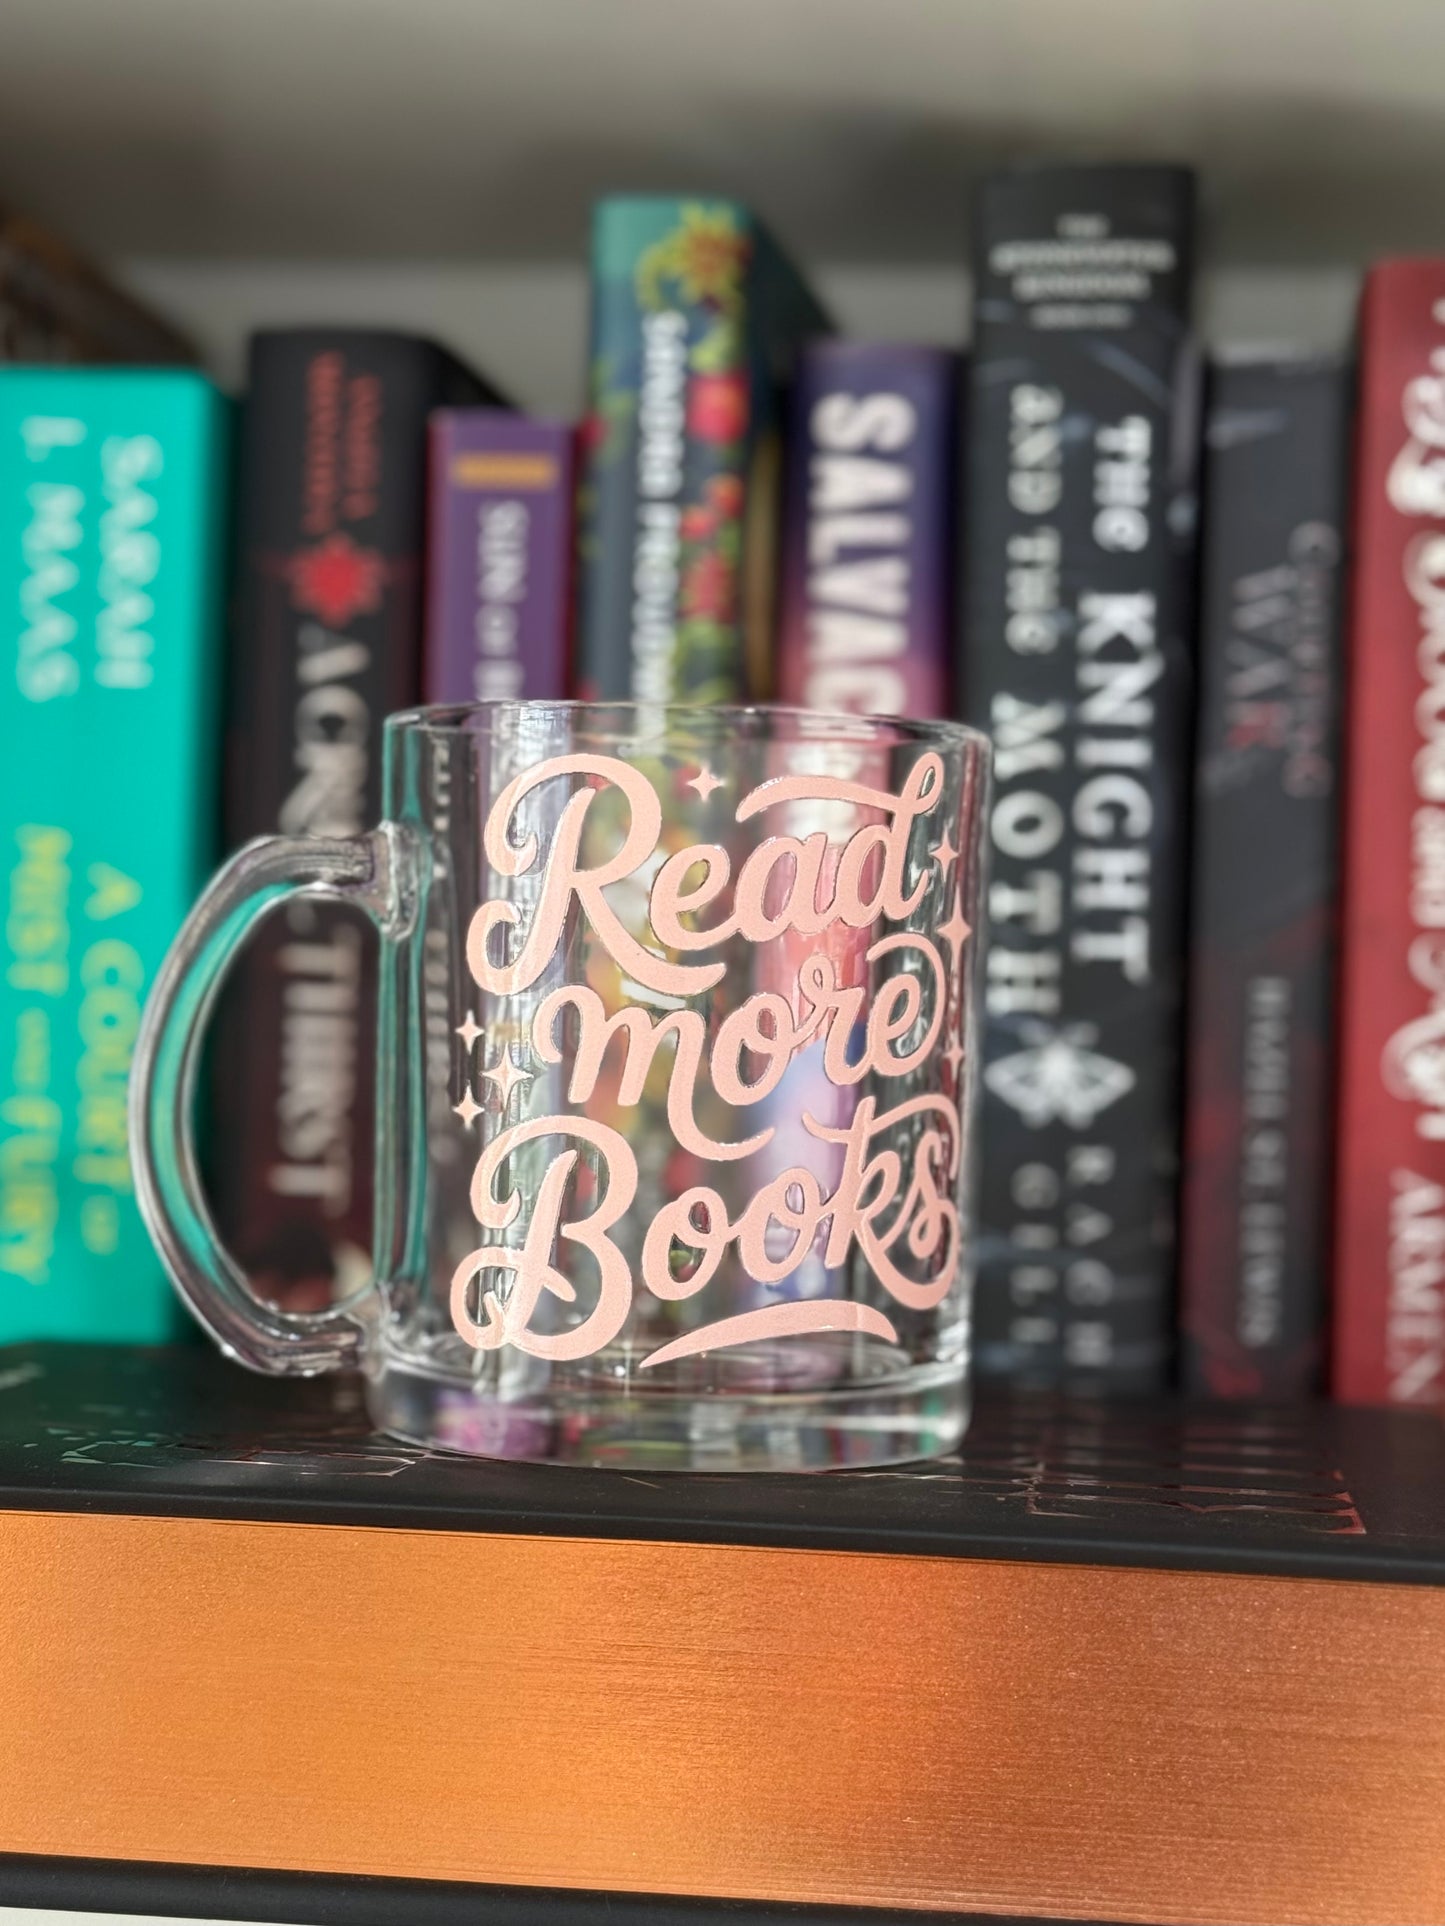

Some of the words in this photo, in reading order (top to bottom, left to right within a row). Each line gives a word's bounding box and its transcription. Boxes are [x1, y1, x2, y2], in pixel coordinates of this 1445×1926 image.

[17, 482, 85, 702] MAAS
[97, 437, 161, 687] SARAH
[808, 393, 915, 716] SALVAC
[466, 752, 944, 998] Read
[987, 693, 1065, 1014] MOTH
[1073, 592, 1163, 982] KNIGHT
[533, 932, 945, 1161] more
[450, 1094, 959, 1361] Books
[1065, 1145, 1115, 1367] RACH
